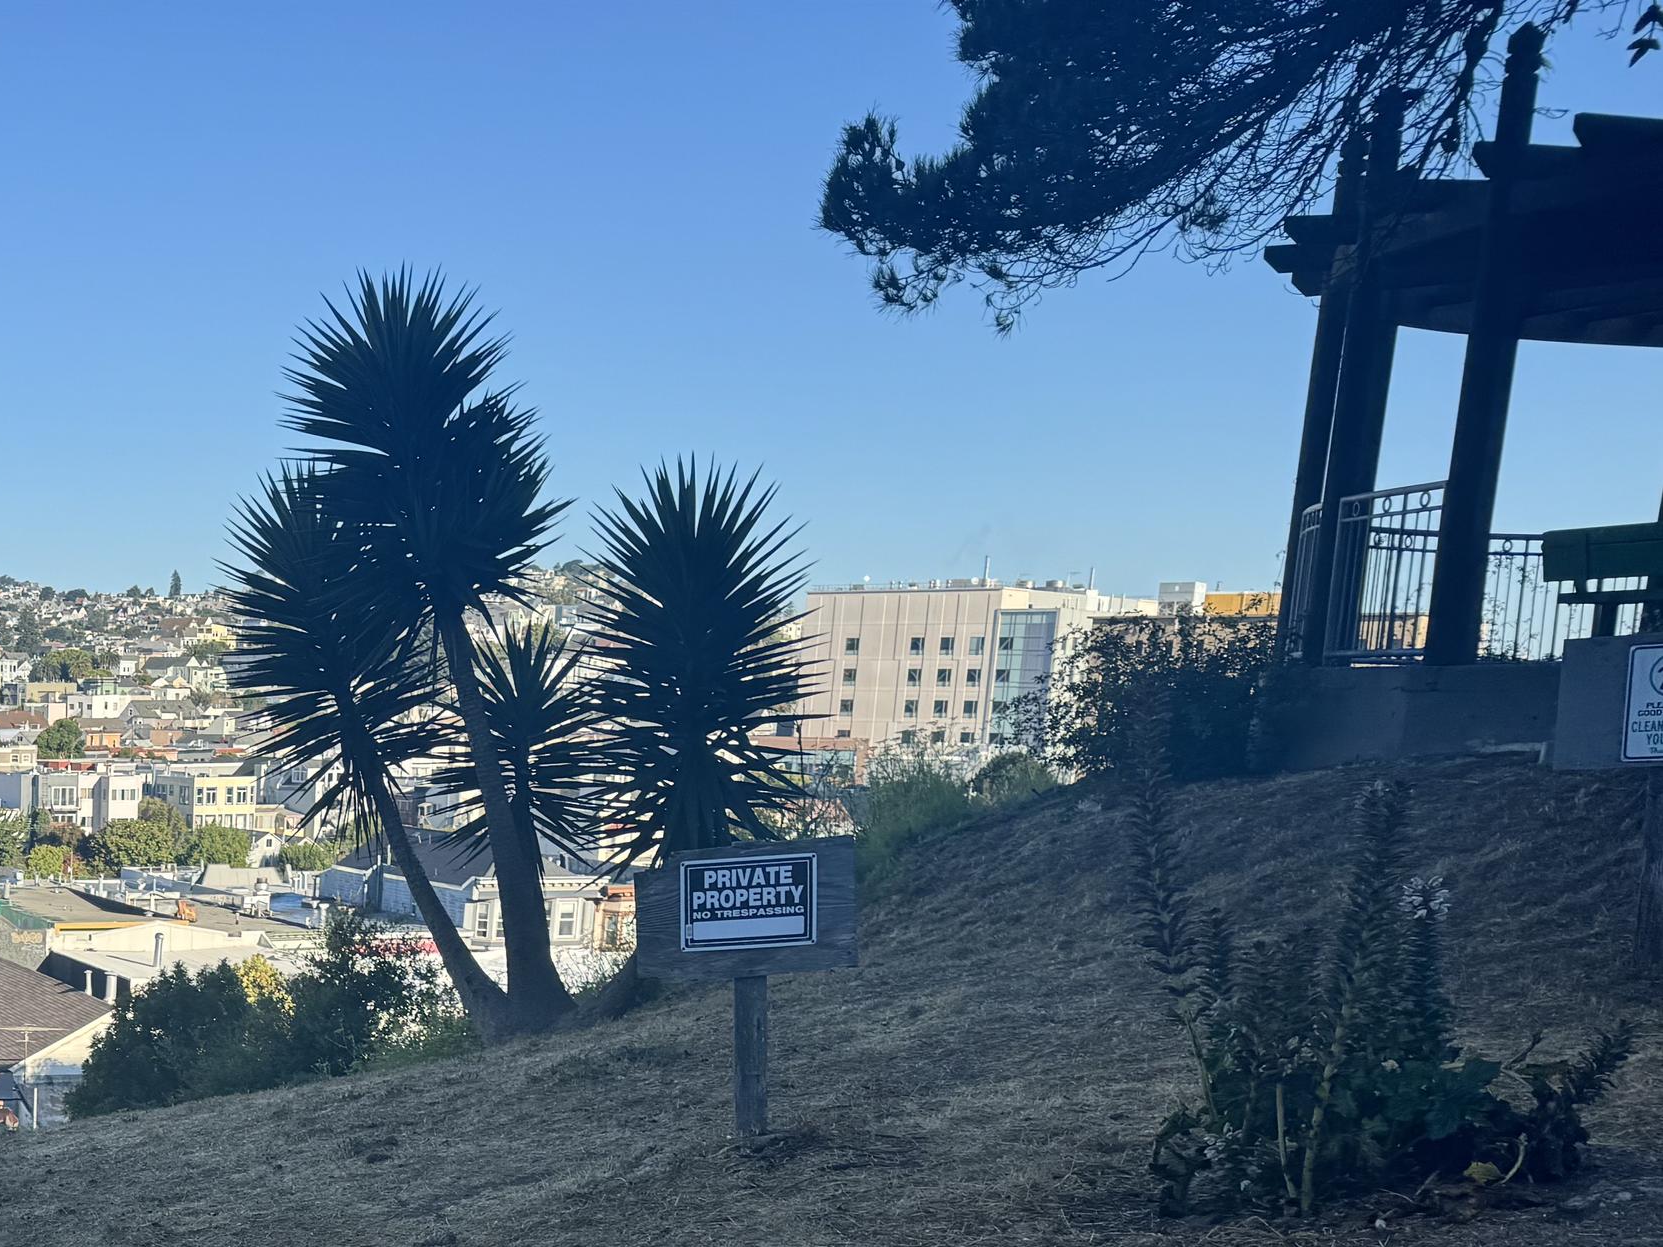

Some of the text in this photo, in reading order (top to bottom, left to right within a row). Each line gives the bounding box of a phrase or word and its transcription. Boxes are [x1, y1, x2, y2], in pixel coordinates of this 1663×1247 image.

[704, 865, 793, 889] PRIVATE
[692, 885, 805, 910] PROPERTY
[692, 905, 805, 920] NO TRESPASSING
